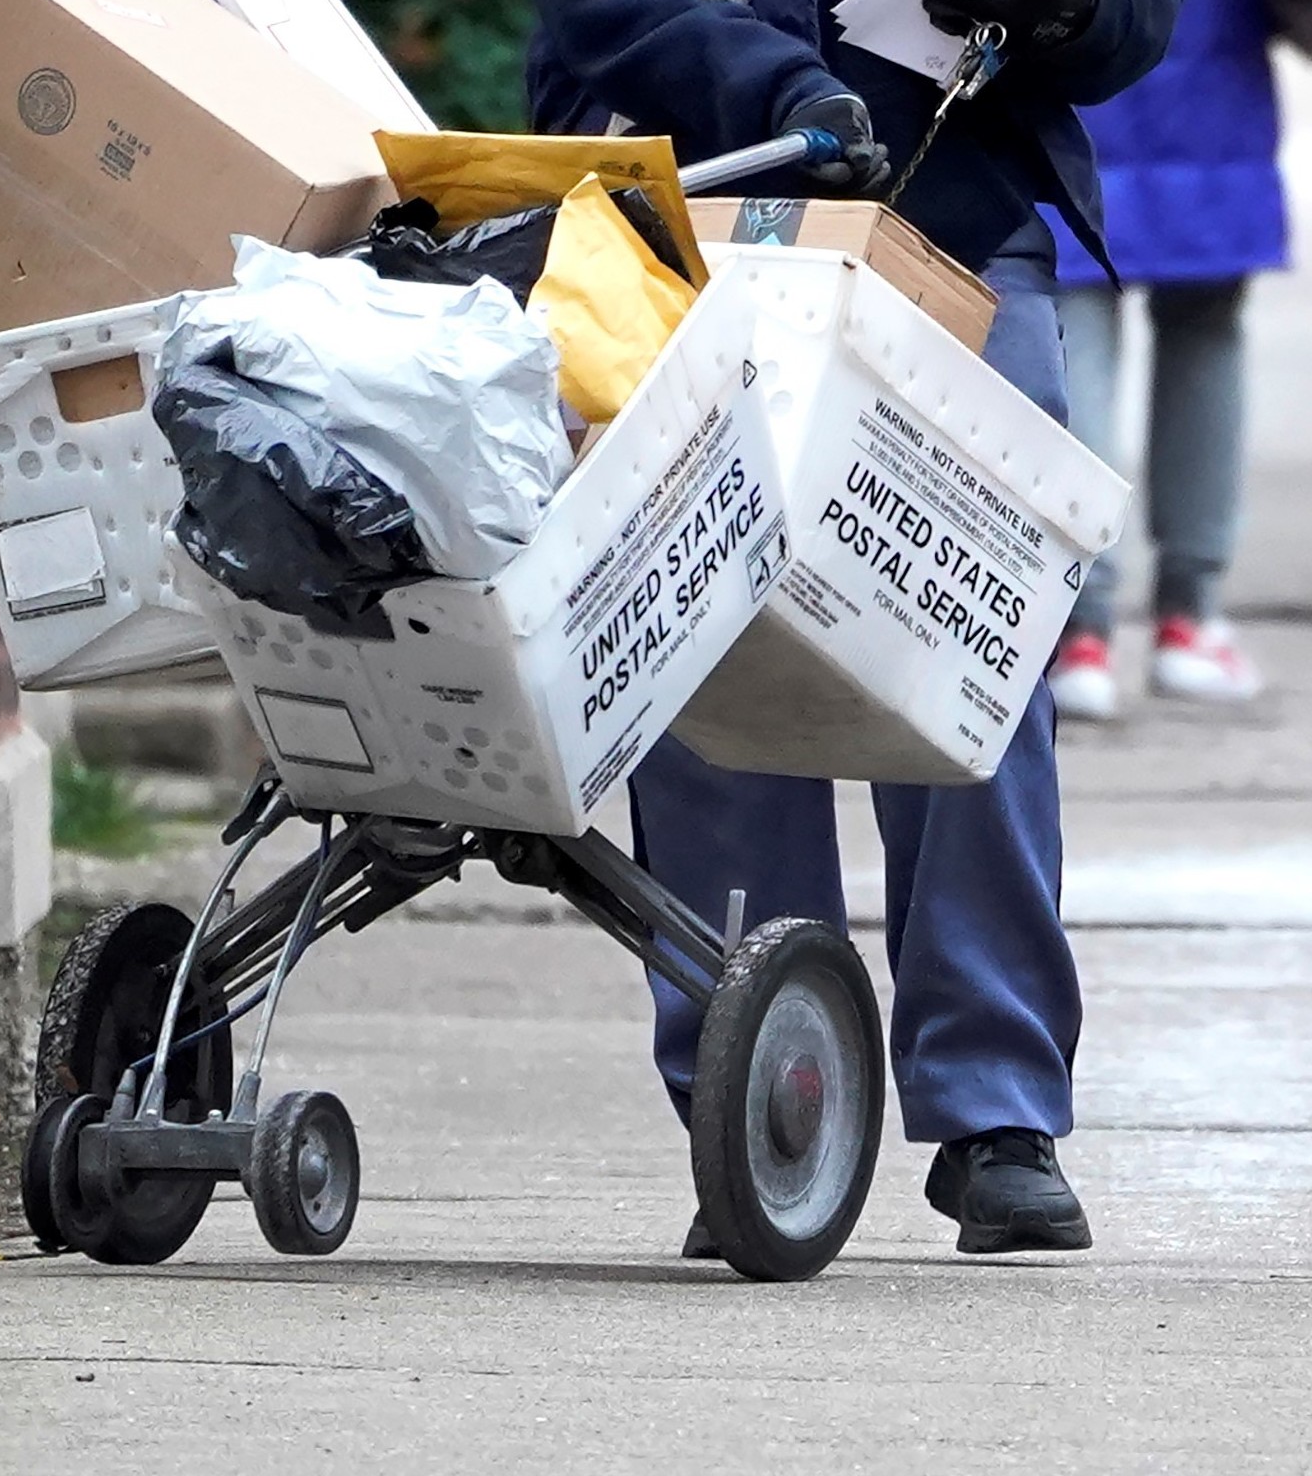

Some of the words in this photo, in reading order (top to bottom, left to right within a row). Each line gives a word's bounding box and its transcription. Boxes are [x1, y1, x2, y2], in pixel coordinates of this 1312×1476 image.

[566, 546, 615, 608] WARNING
[621, 510, 641, 544] NOT
[642, 483, 664, 516] FOR
[663, 431, 702, 489] PRIVATE
[700, 403, 721, 436] USE
[846, 461, 933, 549] UNITED
[934, 535, 1026, 628] STATES
[875, 398, 925, 449] WARNING
[930, 444, 954, 473] NOT
[953, 465, 977, 493] FOR
[977, 486, 1021, 529] PRIVATE
[1020, 515, 1045, 549] USE
[582, 567, 662, 681] UNITED
[667, 457, 746, 577] STATES
[582, 612, 671, 733] POSTAL
[675, 482, 764, 618] SERVICE
[650, 652, 672, 679] FOR
[669, 630, 689, 656] MAIL
[689, 596, 712, 630] ONLY
[818, 498, 912, 595] POSTAL
[917, 578, 1020, 681] SERVICE
[872, 588, 893, 614] FOR
[893, 604, 914, 632] MAIL
[914, 623, 941, 650] ONLY
